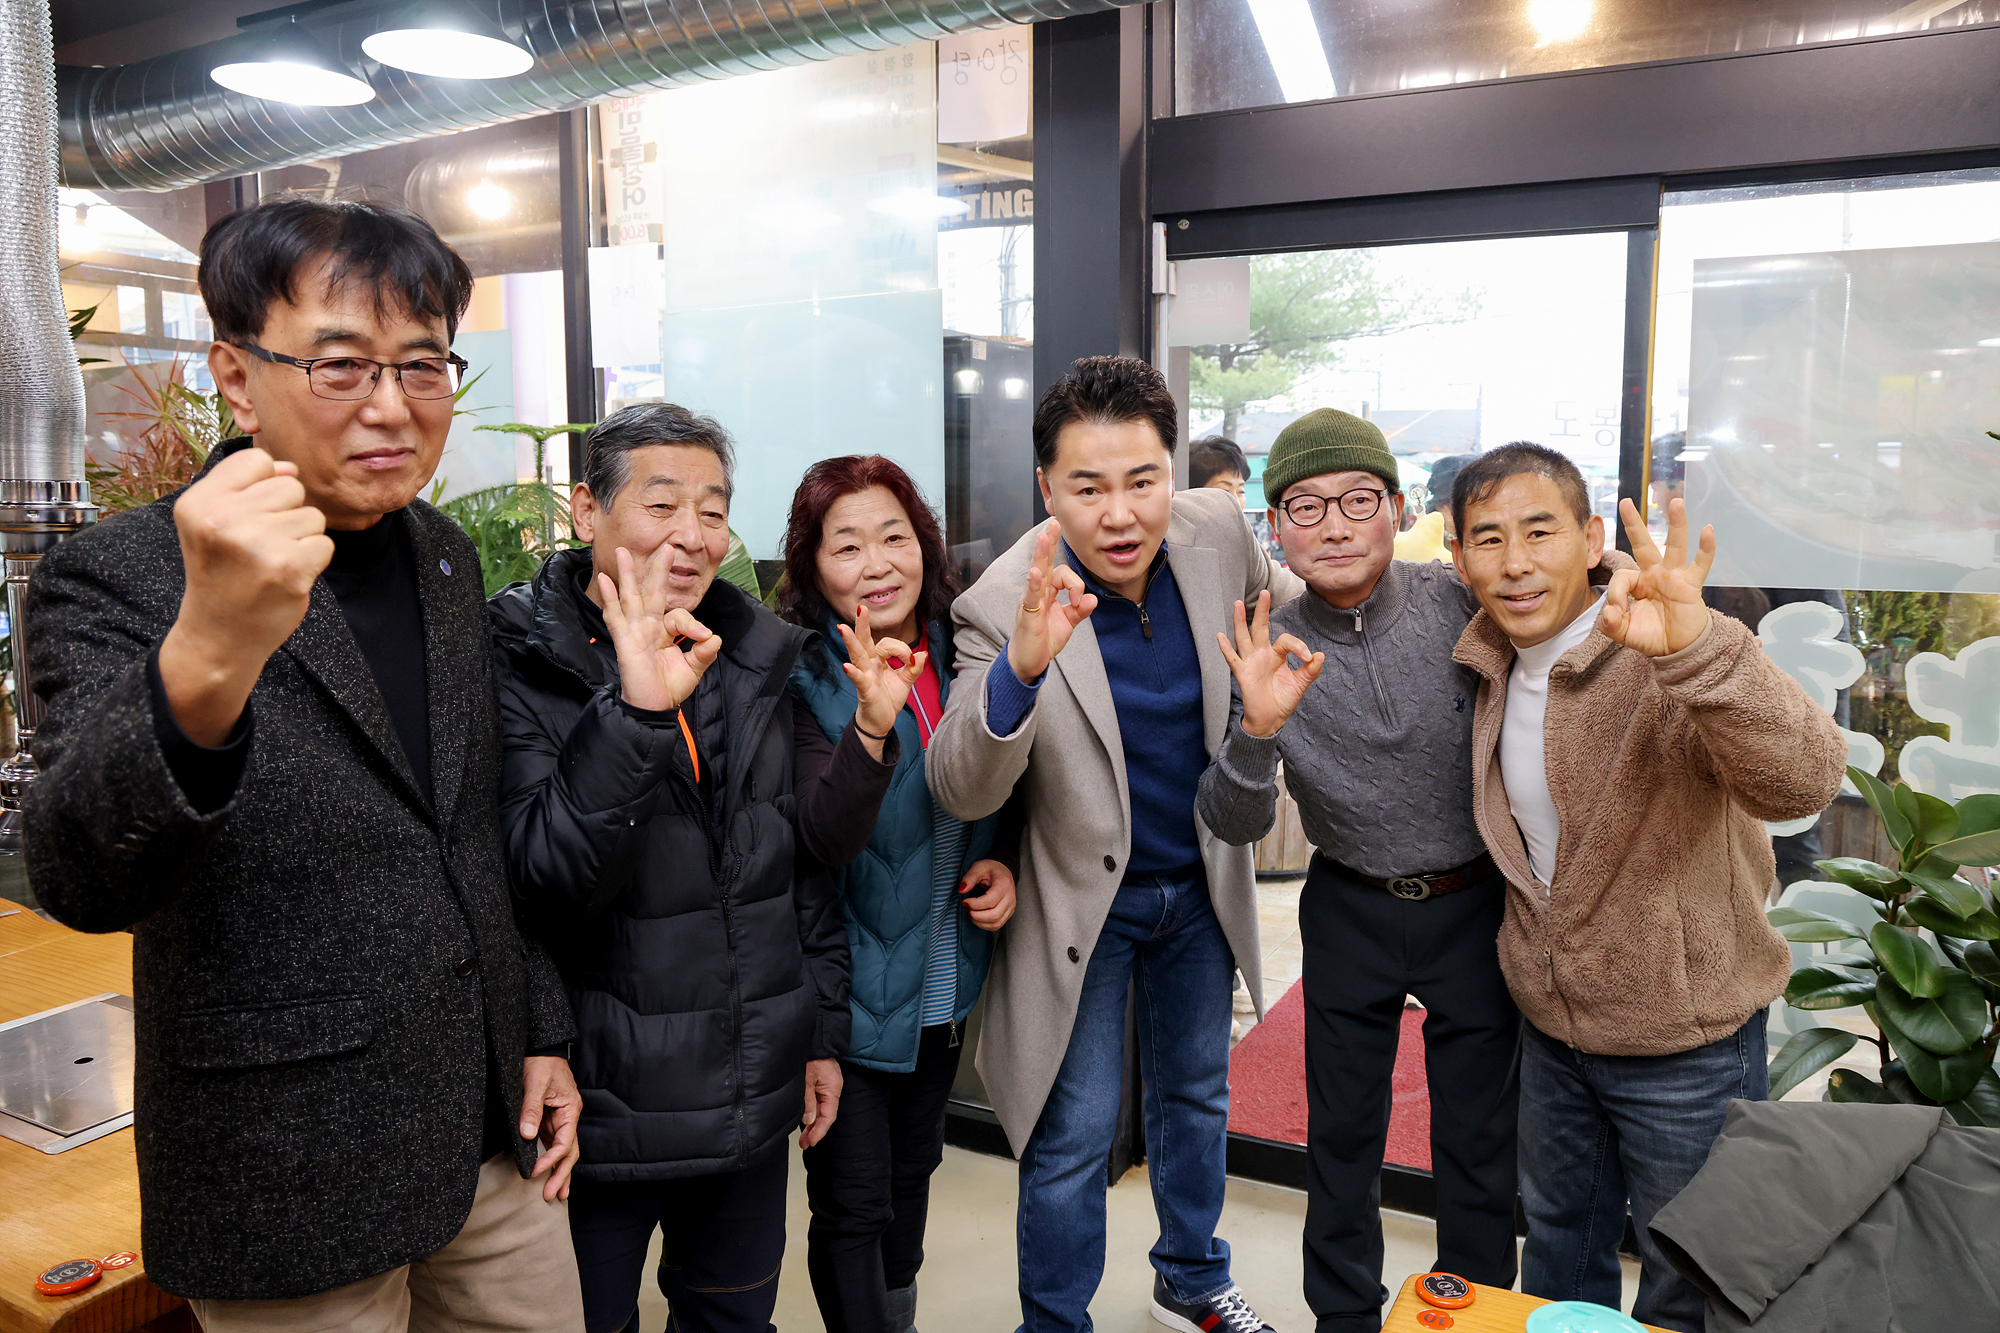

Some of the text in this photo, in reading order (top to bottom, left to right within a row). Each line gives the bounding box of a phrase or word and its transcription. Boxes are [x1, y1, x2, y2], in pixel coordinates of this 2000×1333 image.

[940, 187, 1034, 223] TING
[106, 1254, 131, 1266] 16
[1424, 1313, 1446, 1325] 10
